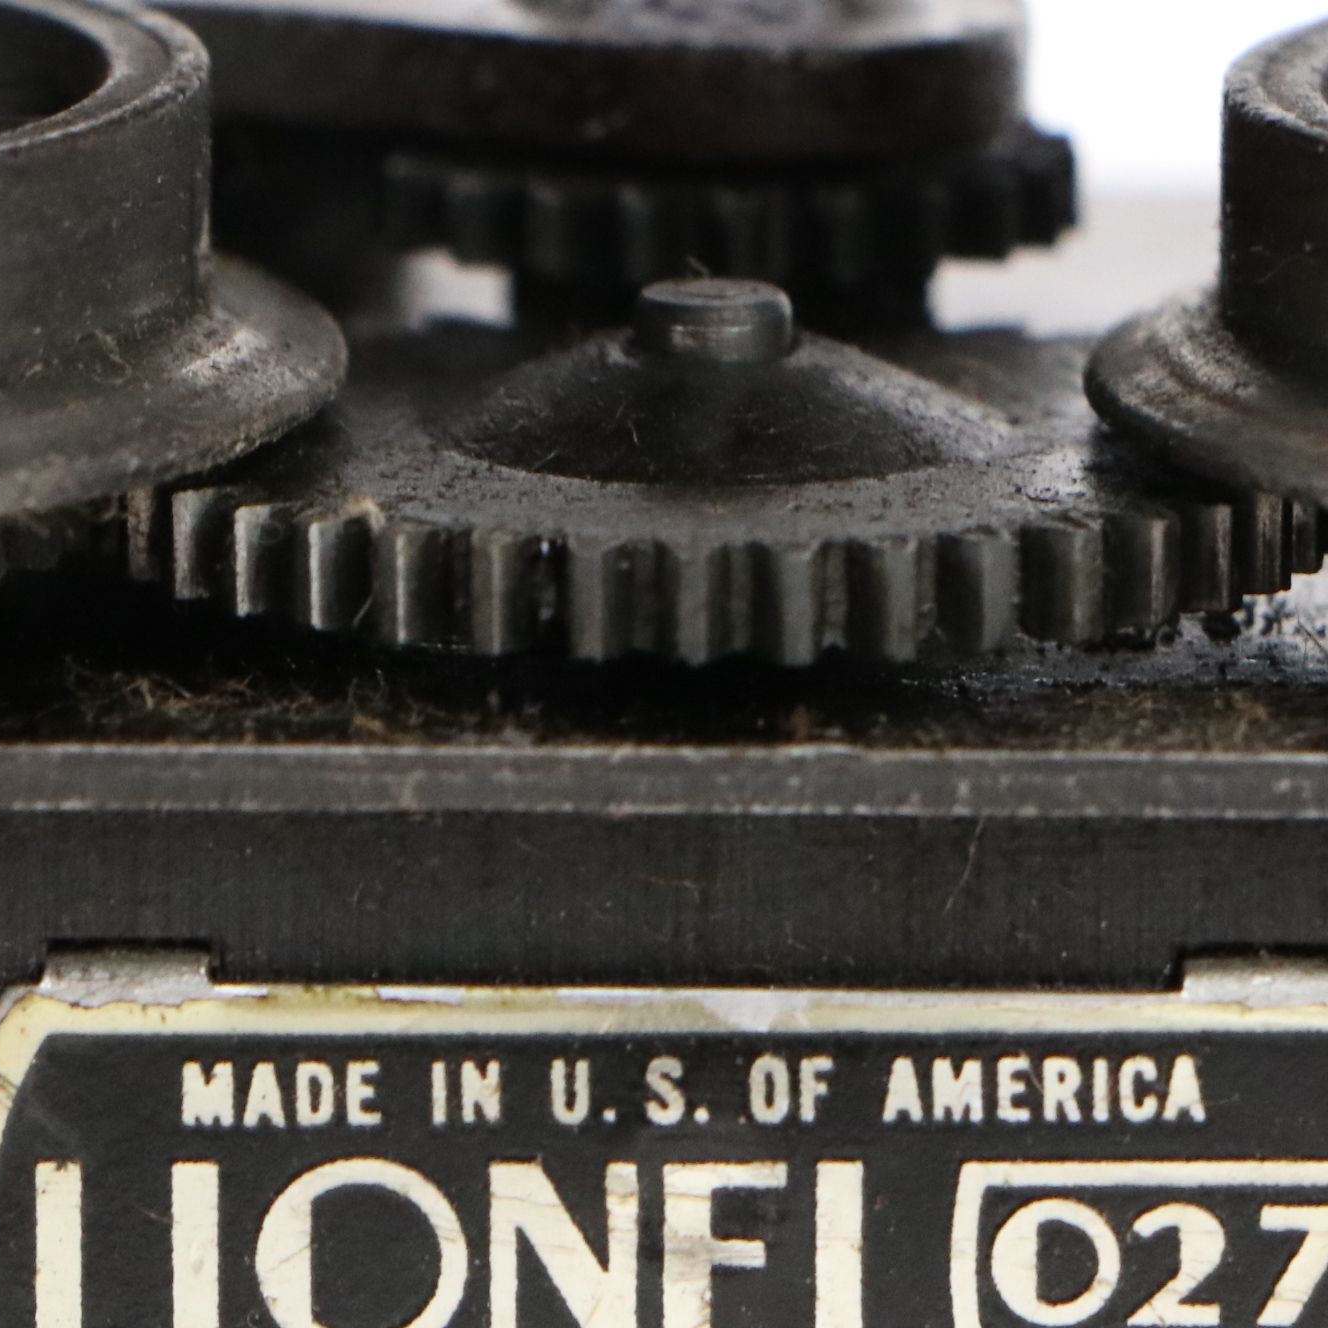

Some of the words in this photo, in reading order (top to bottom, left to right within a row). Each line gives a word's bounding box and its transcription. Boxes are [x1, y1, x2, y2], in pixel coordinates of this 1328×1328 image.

[181, 1060, 382, 1129] MADE
[431, 1059, 501, 1126] IN
[749, 1054, 834, 1125] OF
[882, 1054, 1207, 1124] AMERICA
